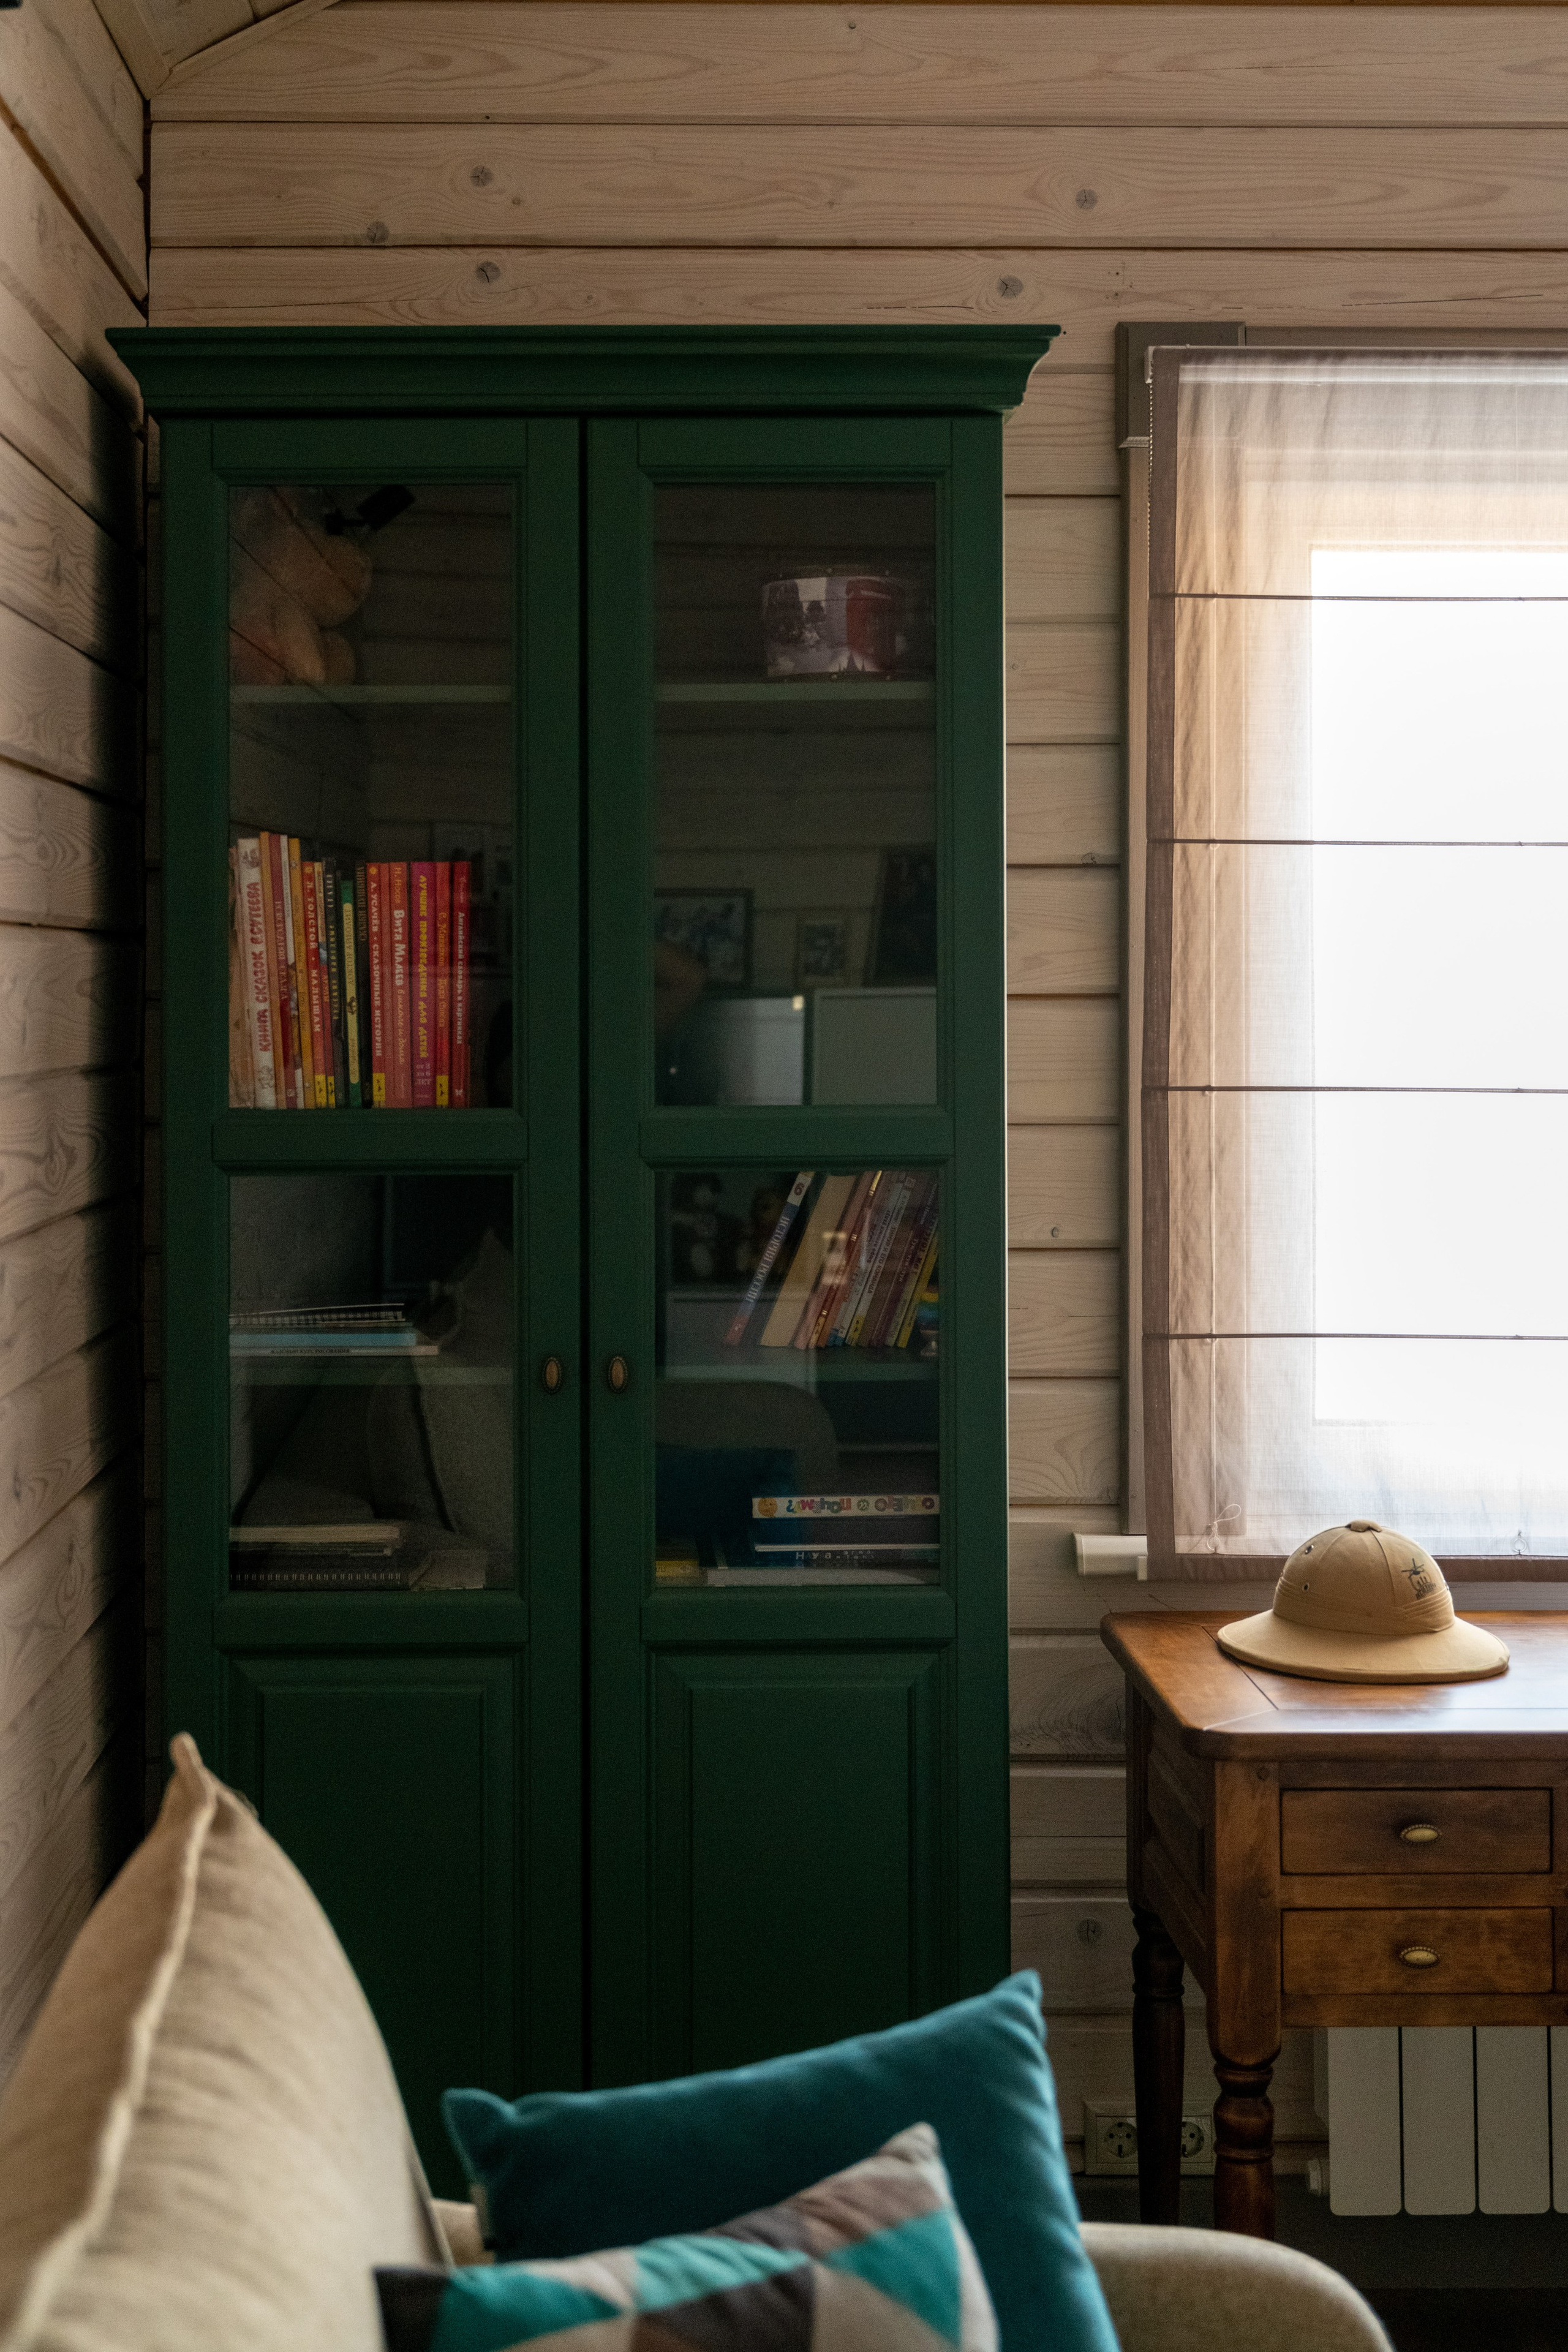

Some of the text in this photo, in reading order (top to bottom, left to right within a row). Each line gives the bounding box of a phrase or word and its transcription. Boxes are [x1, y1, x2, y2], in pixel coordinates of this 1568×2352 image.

[370, 881, 377, 892] А.
[306, 881, 321, 1032] Л. ТОЛСТОЙ МАЛЫШАМ
[346, 952, 355, 986] ДОКТОР
[252, 951, 268, 1003] СКАЗОК
[372, 943, 380, 1006] СКАЗОЧНЫЕ
[455, 960, 464, 993] словарь
[418, 1001, 427, 1023] ДЛЯ
[258, 1009, 271, 1052] КНИГА
[418, 1026, 428, 1058] ДЕТЕЙ
[793, 1181, 805, 1196] 6
[763, 1215, 791, 1263] ИСТОРИЯ
[884, 1226, 896, 1247] ТИМУР
[866, 1264, 882, 1294] КОМАНДА
